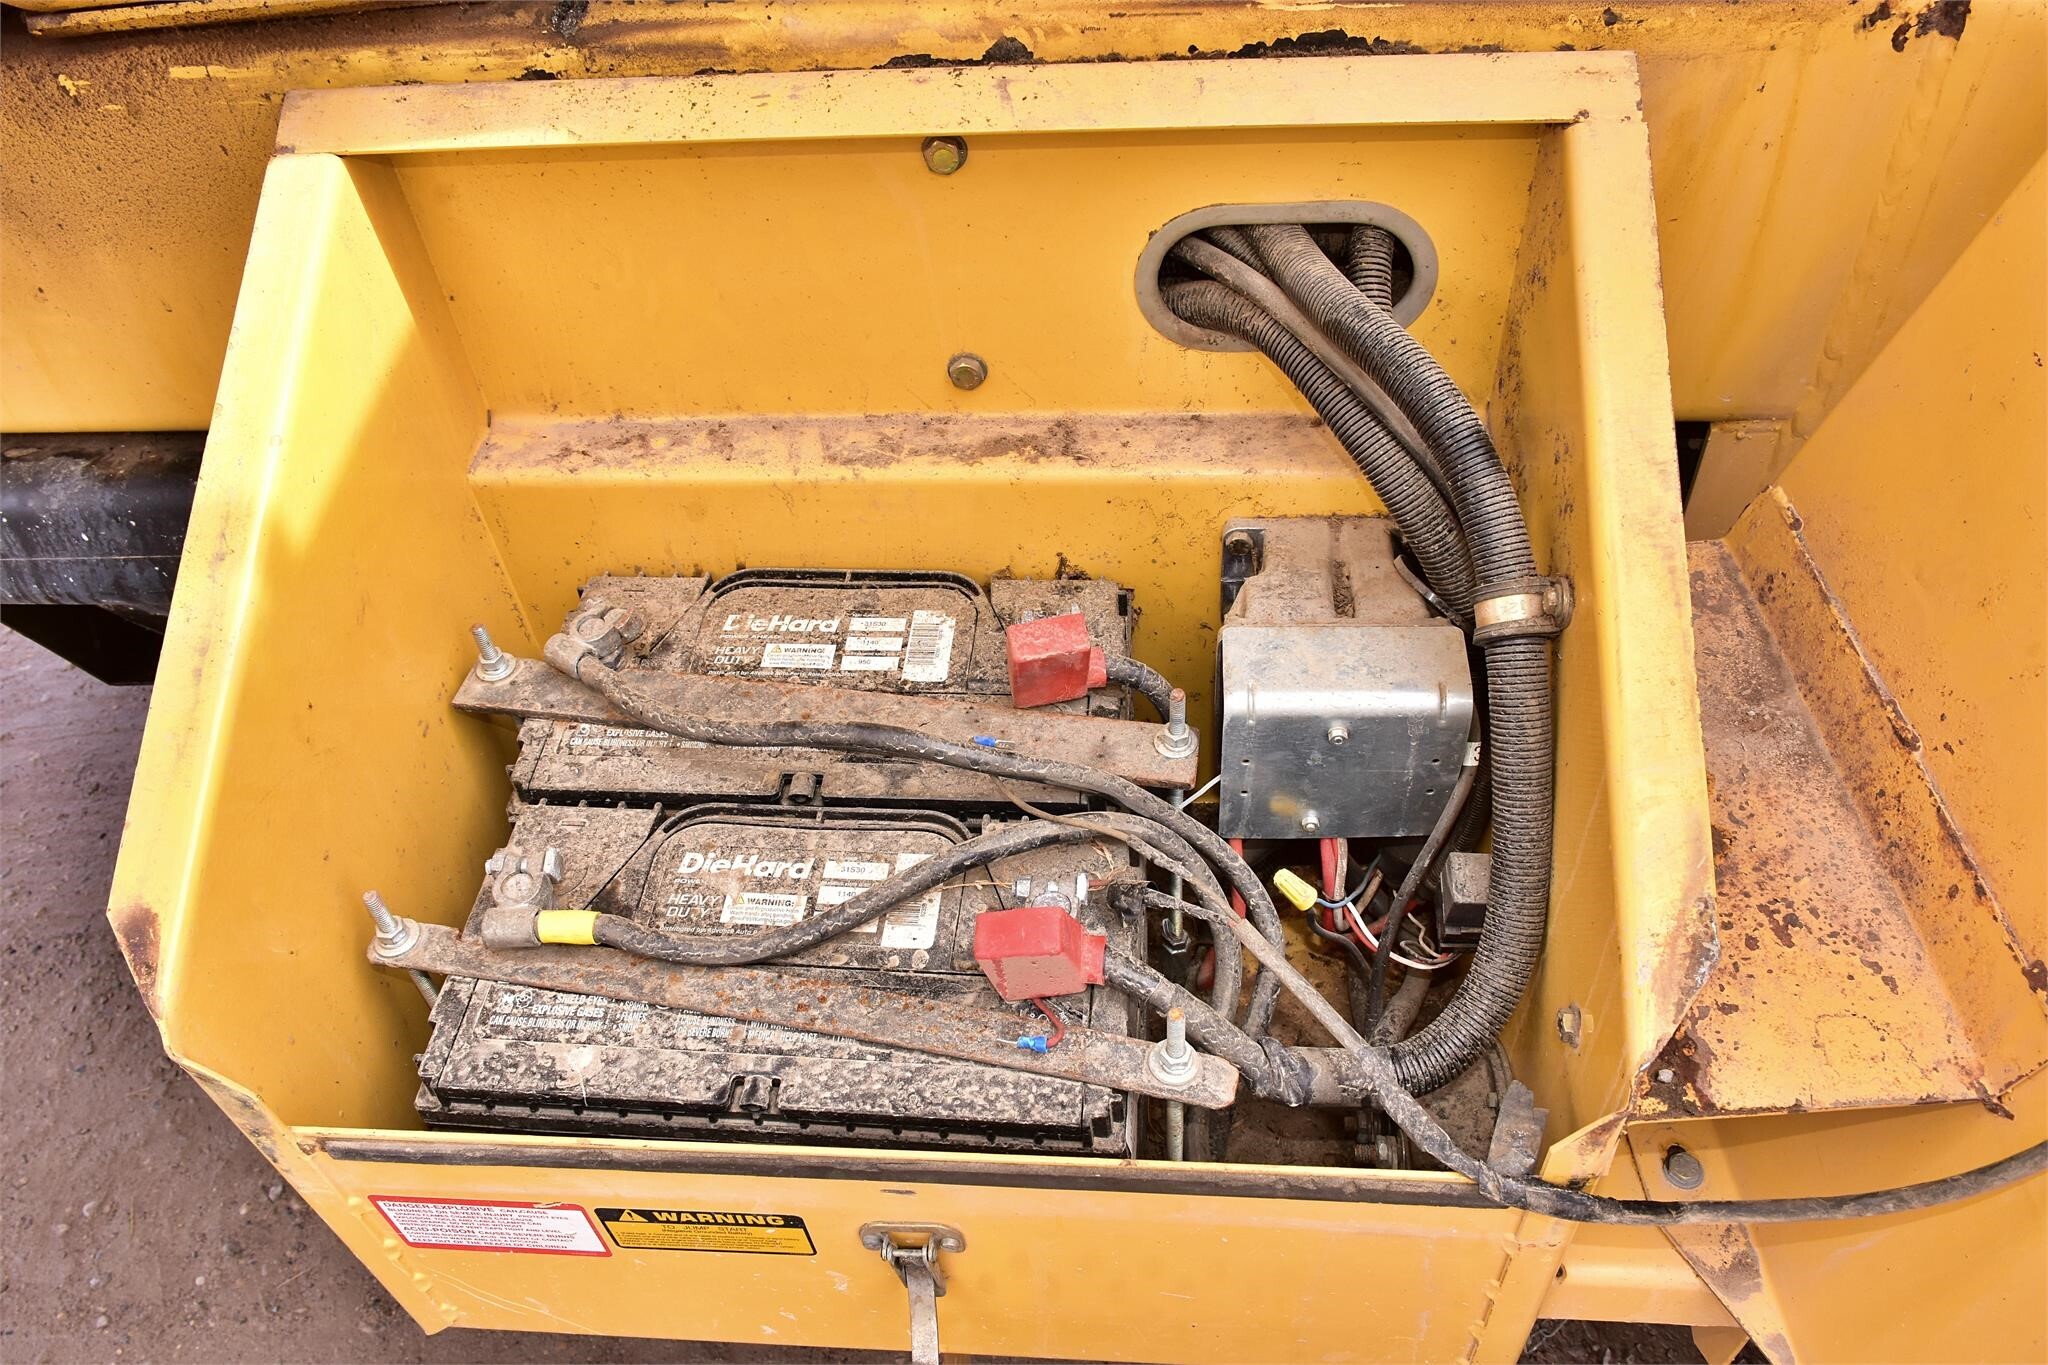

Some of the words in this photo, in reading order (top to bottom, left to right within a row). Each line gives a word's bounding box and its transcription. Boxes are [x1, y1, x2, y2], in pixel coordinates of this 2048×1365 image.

[714, 646, 762, 655] HEAVY
[606, 728, 644, 738] EXPLOSIVE
[677, 852, 815, 879] DieHard
[667, 893, 720, 905] HEAVY
[747, 897, 795, 908] WARNING:
[665, 906, 710, 919] DUY
[532, 1004, 576, 1016] EXPLOSIVE
[576, 1007, 606, 1018] GASES
[489, 1015, 504, 1026] CAN
[504, 1016, 527, 1027] CAUSE
[528, 1017, 565, 1028] BLINDNESS
[565, 1018, 577, 1029] OR
[712, 1028, 736, 1039] BURN
[382, 1202, 494, 1211] DANGER-EXPLOSIVE
[652, 1211, 785, 1226] WARNING
